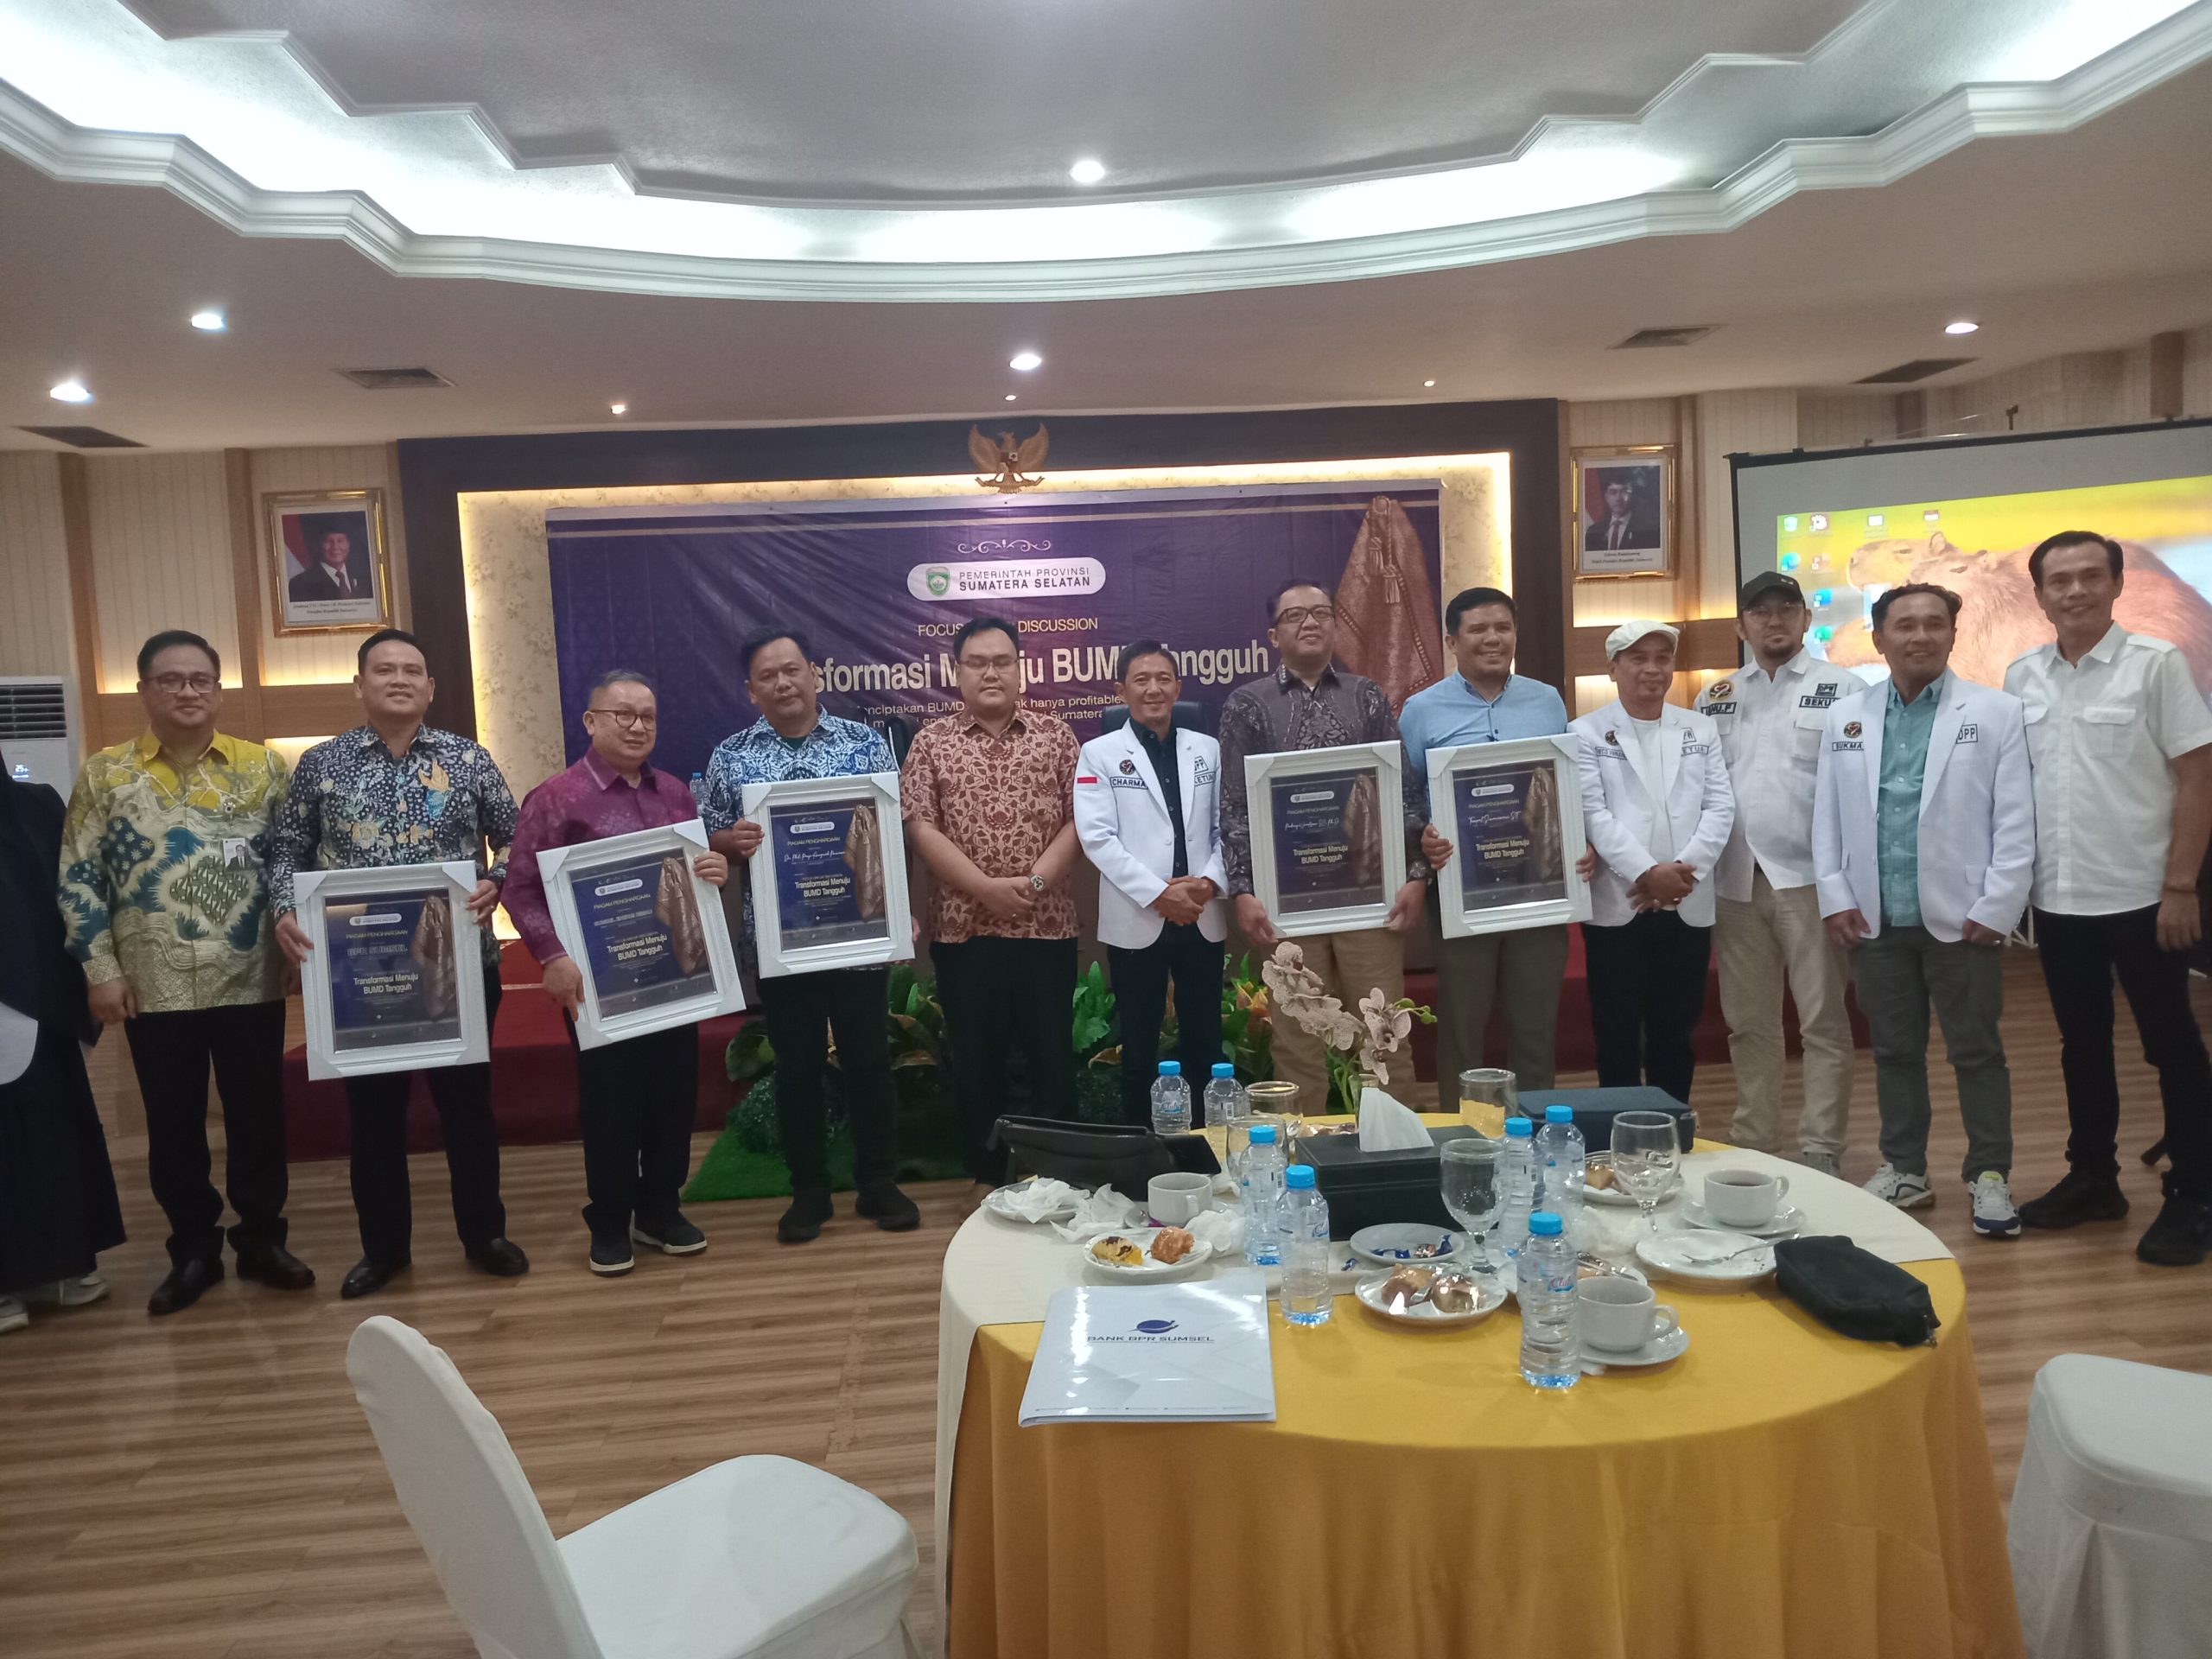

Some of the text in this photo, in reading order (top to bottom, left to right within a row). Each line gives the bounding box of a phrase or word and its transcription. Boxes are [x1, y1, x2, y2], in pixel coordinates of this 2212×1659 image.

[959, 567, 1090, 580] PEMERINTAH PROVINSI
[959, 576, 1090, 591] SUMATERA SELATAN
[918, 618, 1098, 637] FOCUS DISCUSSION
[816, 653, 931, 693] sformasi
[1052, 645, 1127, 683] BUM
[1161, 639, 1268, 685] ngguh
[864, 704, 925, 715] nciptakan
[927, 701, 965, 713] BUMD
[1030, 698, 1065, 709] hanya
[1069, 695, 1122, 708] profitable
[1804, 697, 1835, 707] SEKU
[1112, 779, 1147, 787] CHARMA
[1293, 847, 1328, 856] Transformasi
[1301, 853, 1343, 864] BUMD Tangguh
[795, 880, 830, 889] Transformasi
[830, 876, 851, 885] Menuju
[803, 886, 846, 898] BUMD Tangguh
[607, 938, 645, 953] Transformasi
[645, 933, 668, 944] Menuju
[617, 944, 664, 961] BUMD Tangguh
[353, 972, 419, 985] Transformasi Menuju
[363, 982, 412, 995] BUMD Tangguh
